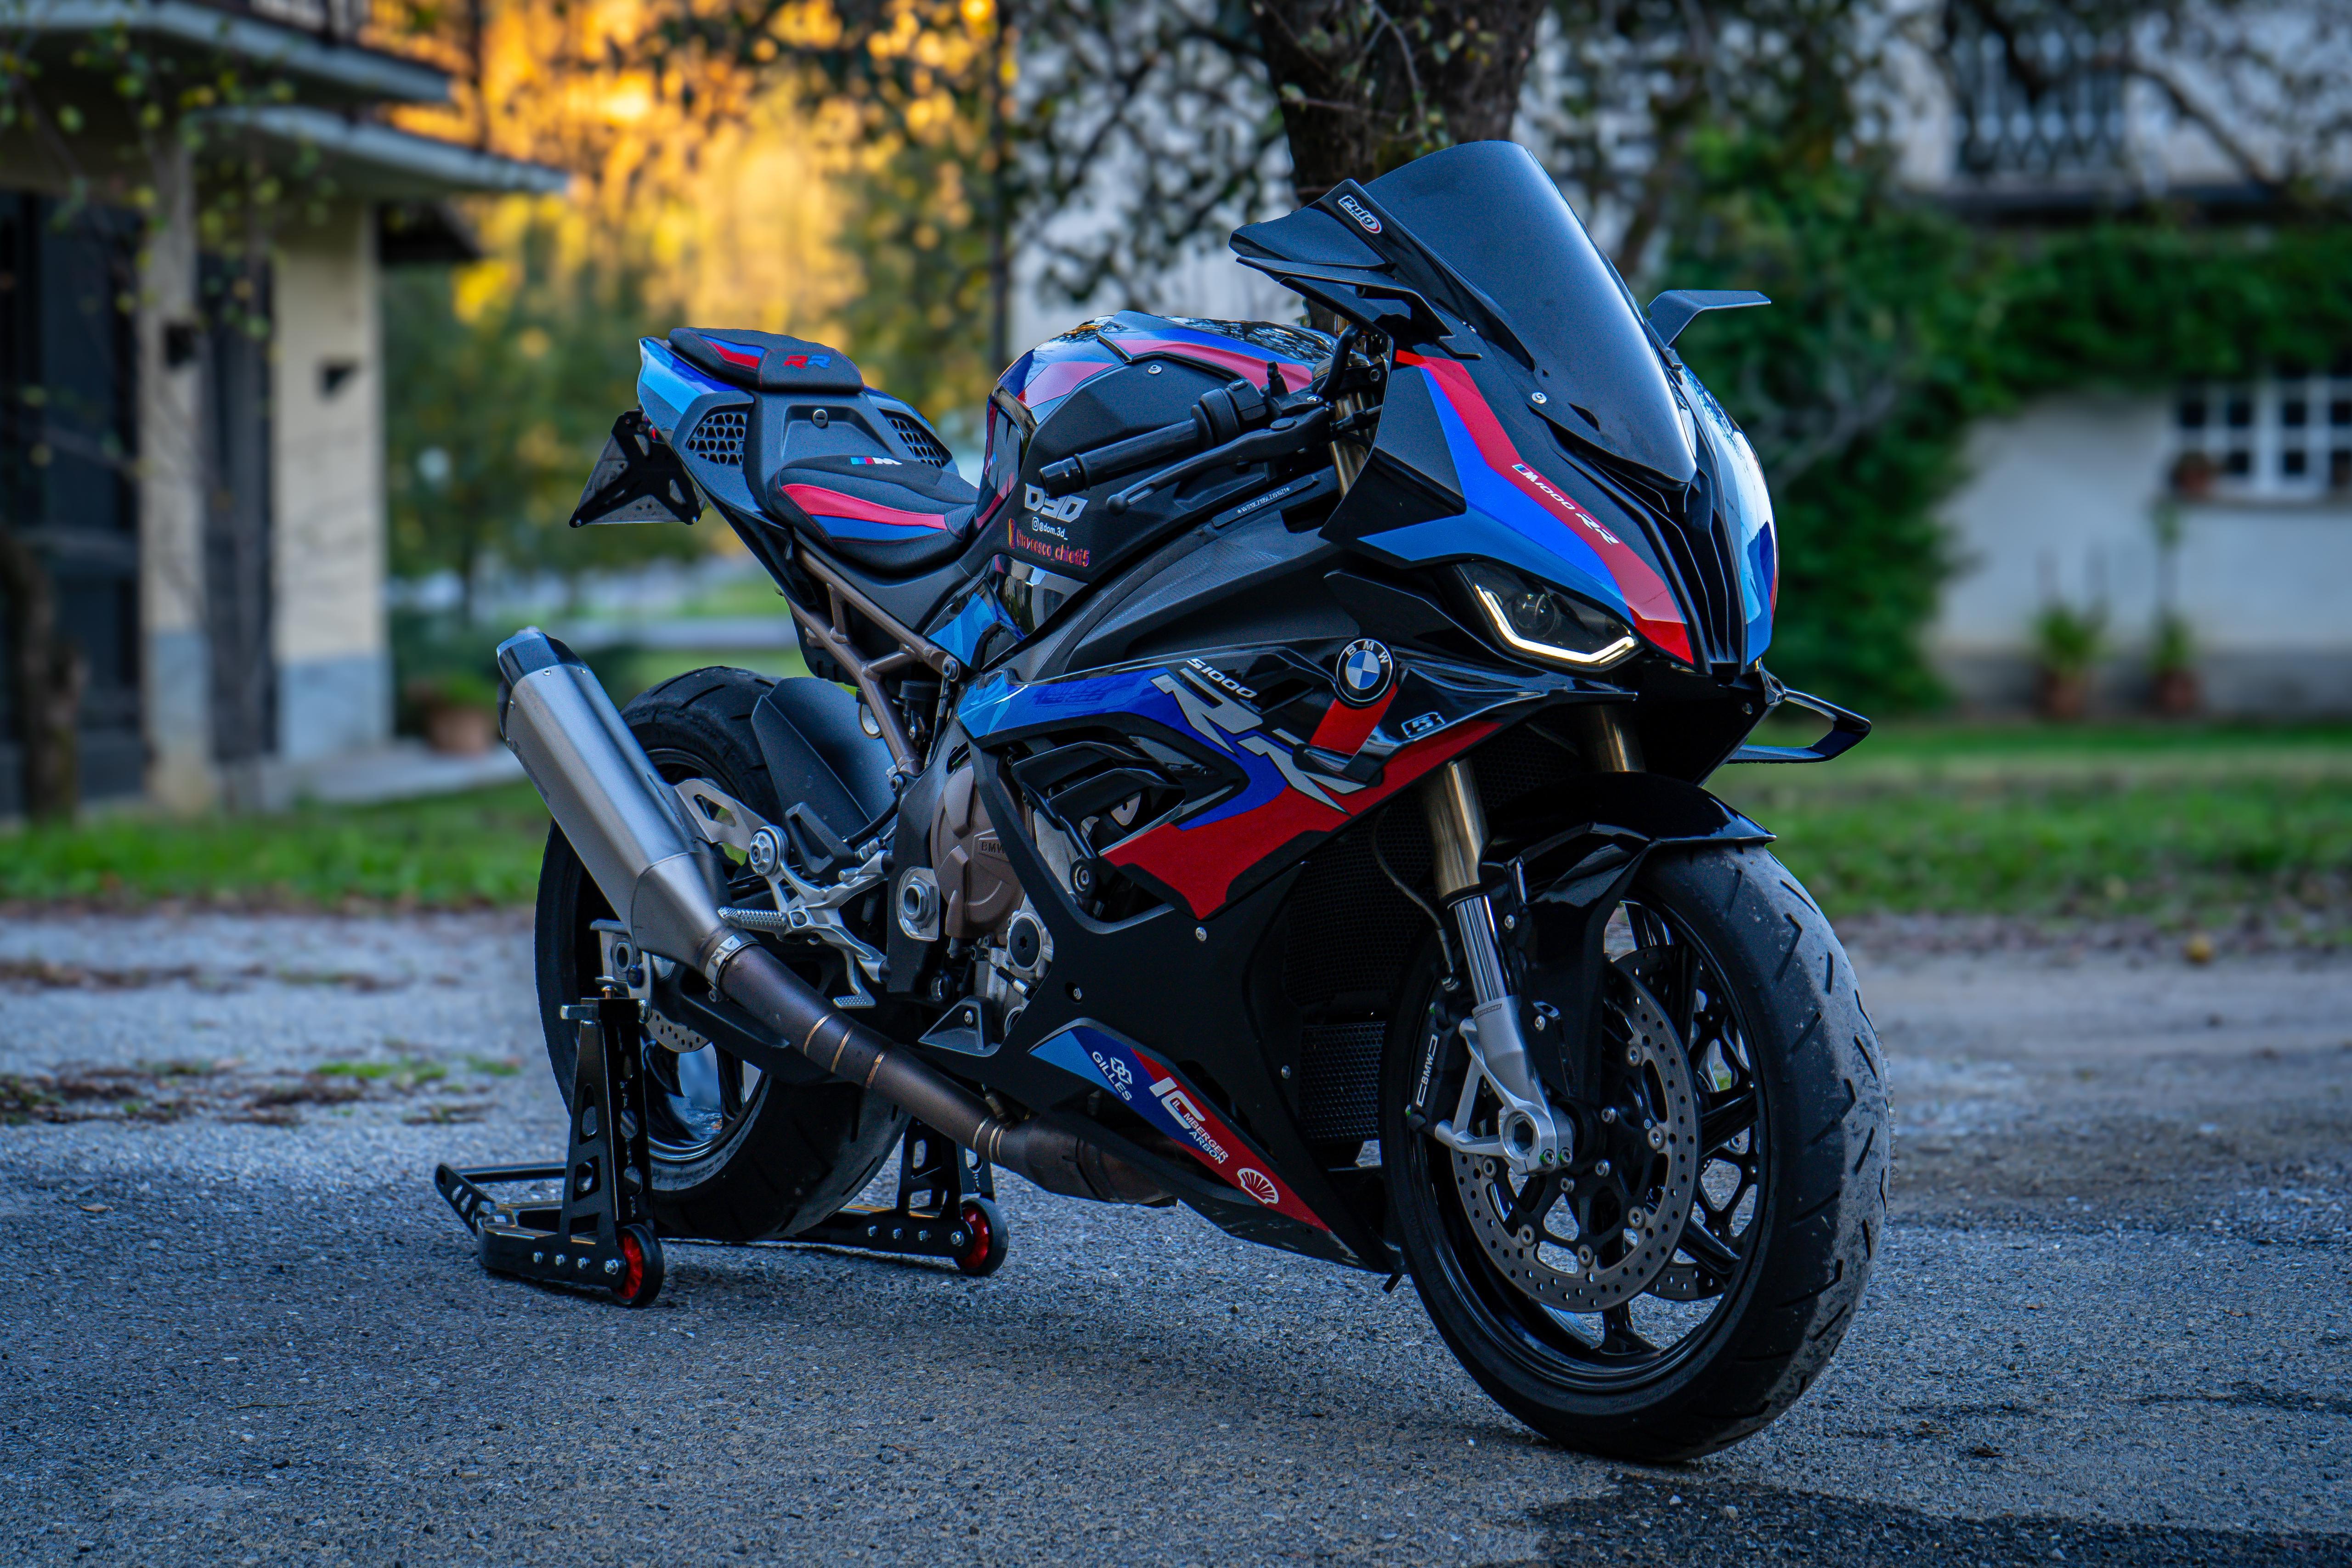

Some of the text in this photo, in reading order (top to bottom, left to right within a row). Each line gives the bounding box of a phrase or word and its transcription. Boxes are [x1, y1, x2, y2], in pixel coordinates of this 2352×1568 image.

[1341, 197, 1375, 225] Puig
[782, 355, 831, 369] RR
[1039, 522, 1068, 541] @dom.3d_
[1575, 513, 1620, 545] RR
[1345, 640, 1389, 664] BMW
[1187, 658, 1258, 698] S1000
[1092, 1051, 1132, 1101] GILLES
[1421, 1052, 1434, 1086] BMW
